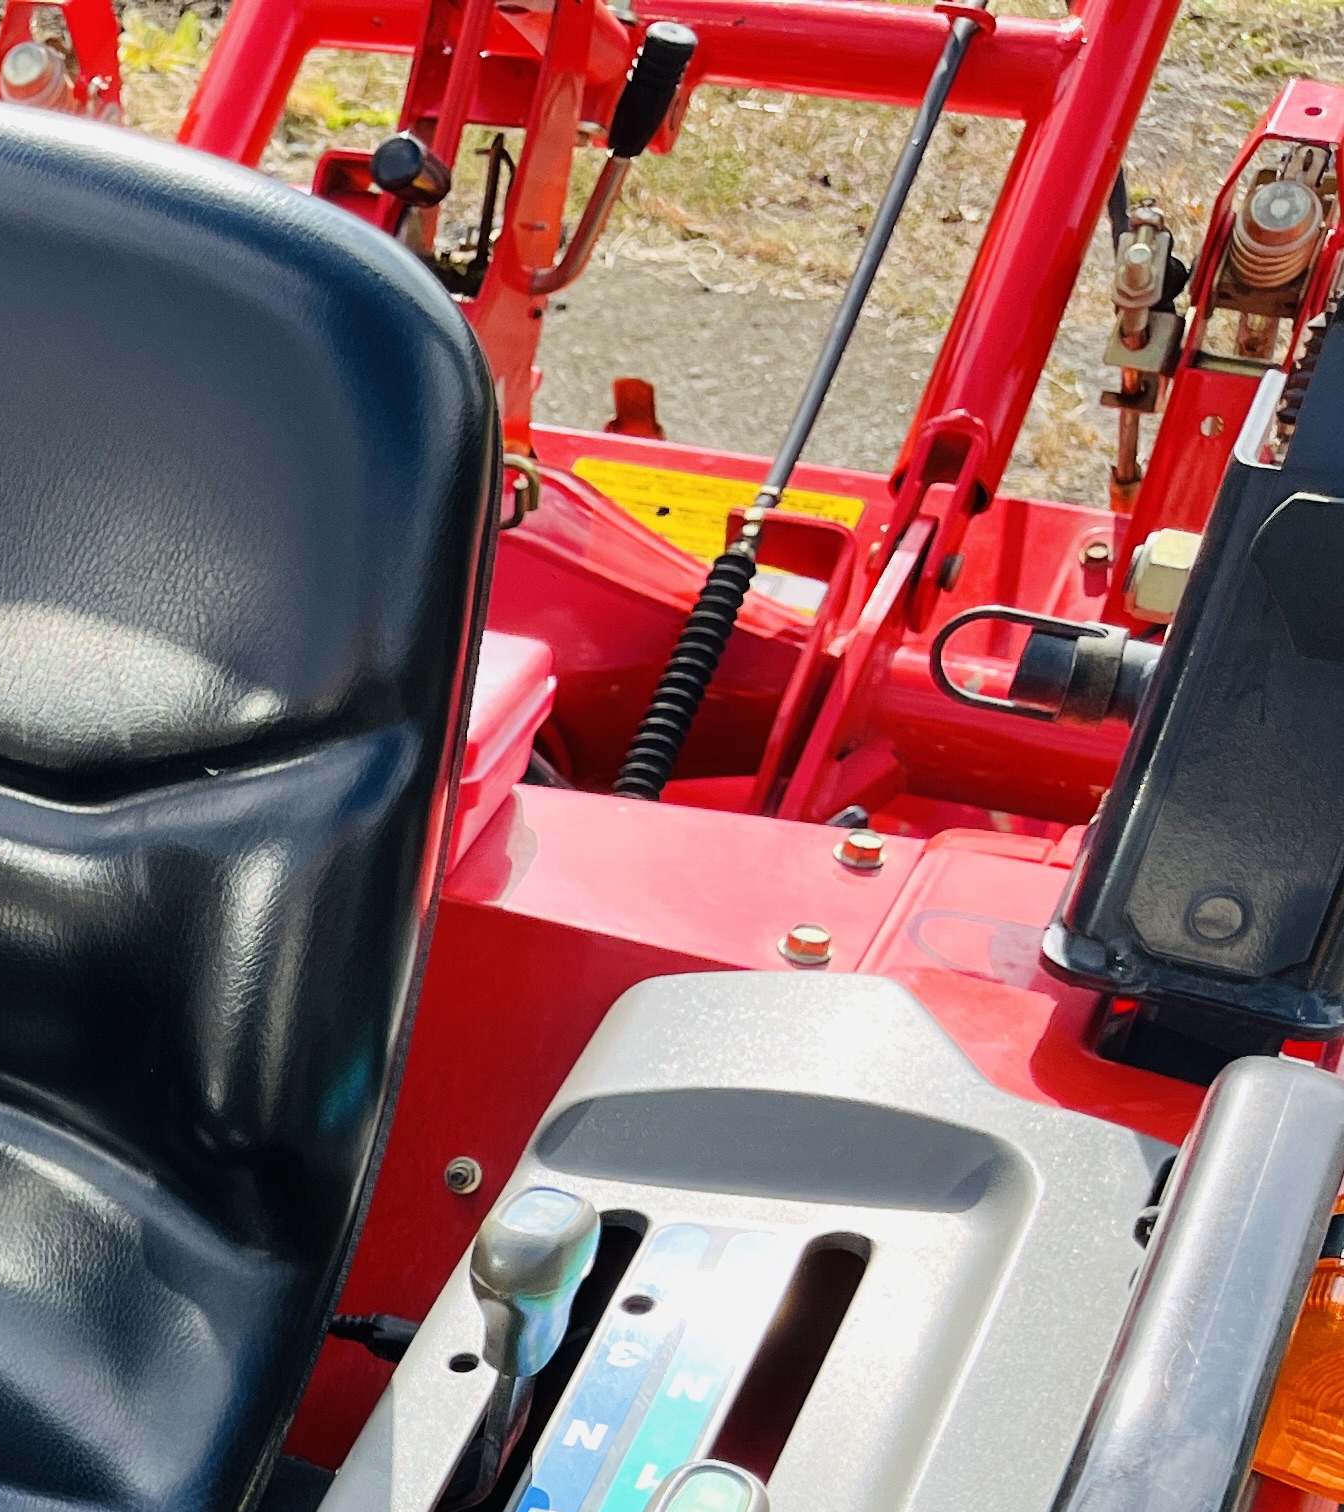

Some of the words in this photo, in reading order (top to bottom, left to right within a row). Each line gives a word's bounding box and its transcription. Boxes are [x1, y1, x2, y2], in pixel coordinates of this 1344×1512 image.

[607, 1339, 650, 1369] 3
[666, 1372, 715, 1402] N
[563, 1420, 610, 1451] N
